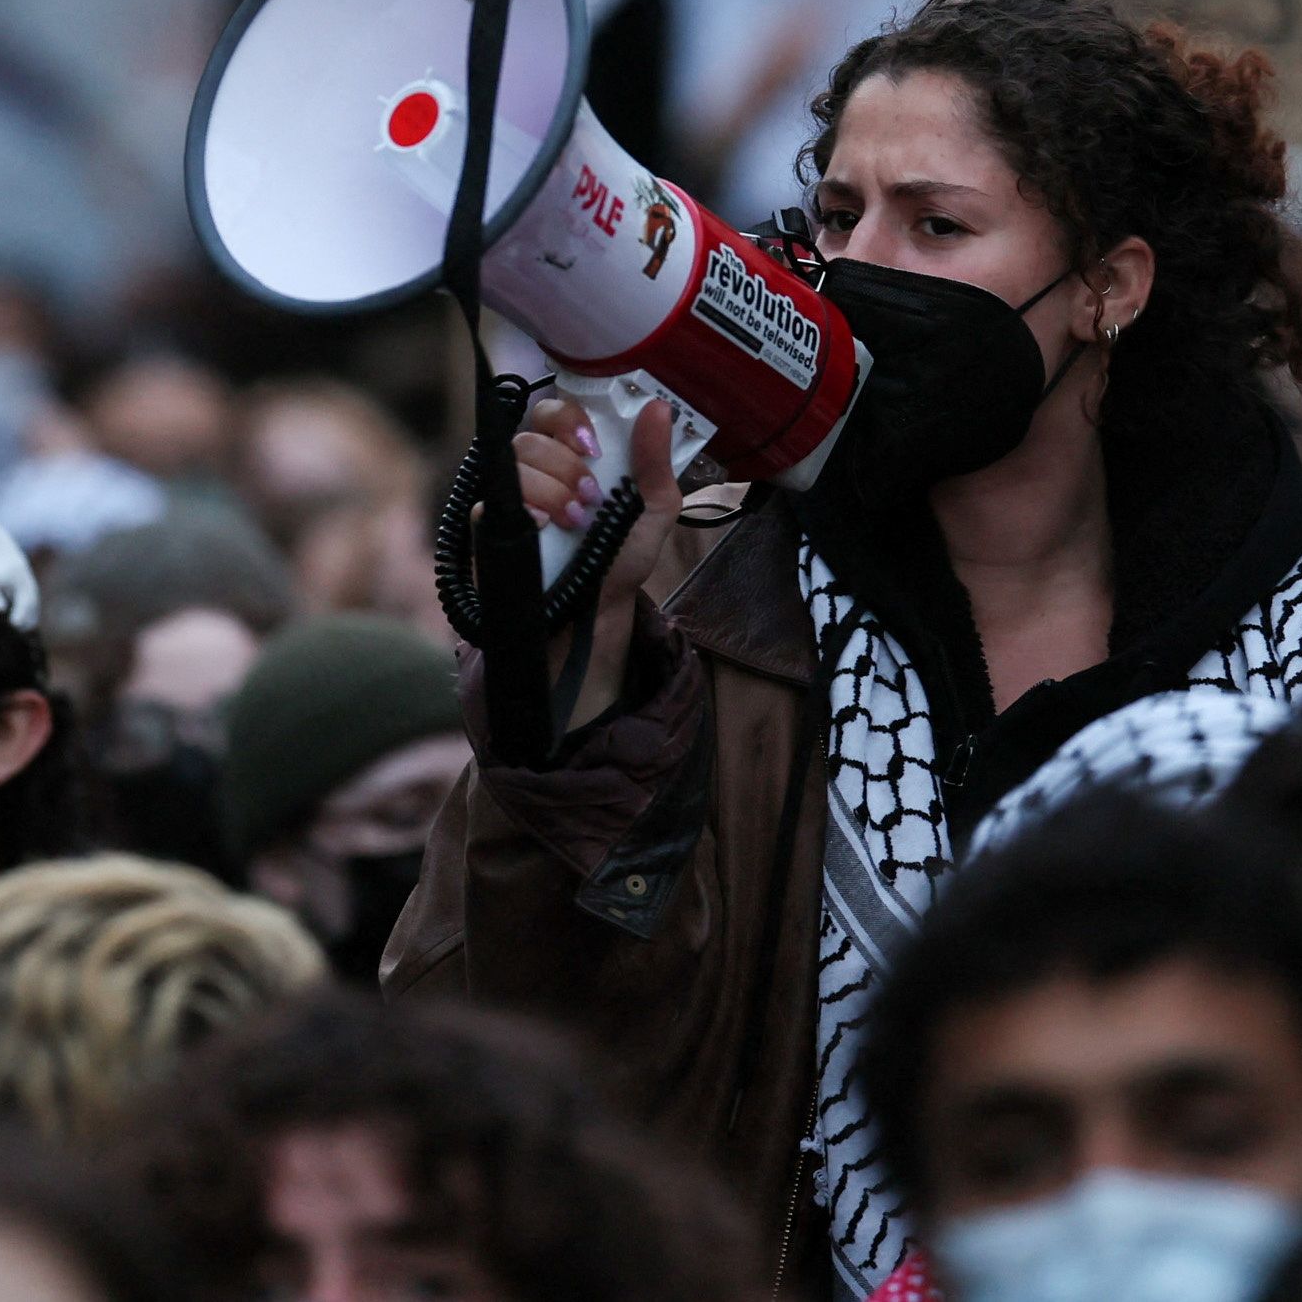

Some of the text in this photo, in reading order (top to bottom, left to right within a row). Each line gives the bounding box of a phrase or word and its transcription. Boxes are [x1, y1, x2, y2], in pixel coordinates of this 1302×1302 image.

[572, 164, 625, 238] PYLE
[724, 249, 743, 272] The
[704, 283, 814, 372] will not be televised.
[709, 254, 818, 352] revolution
